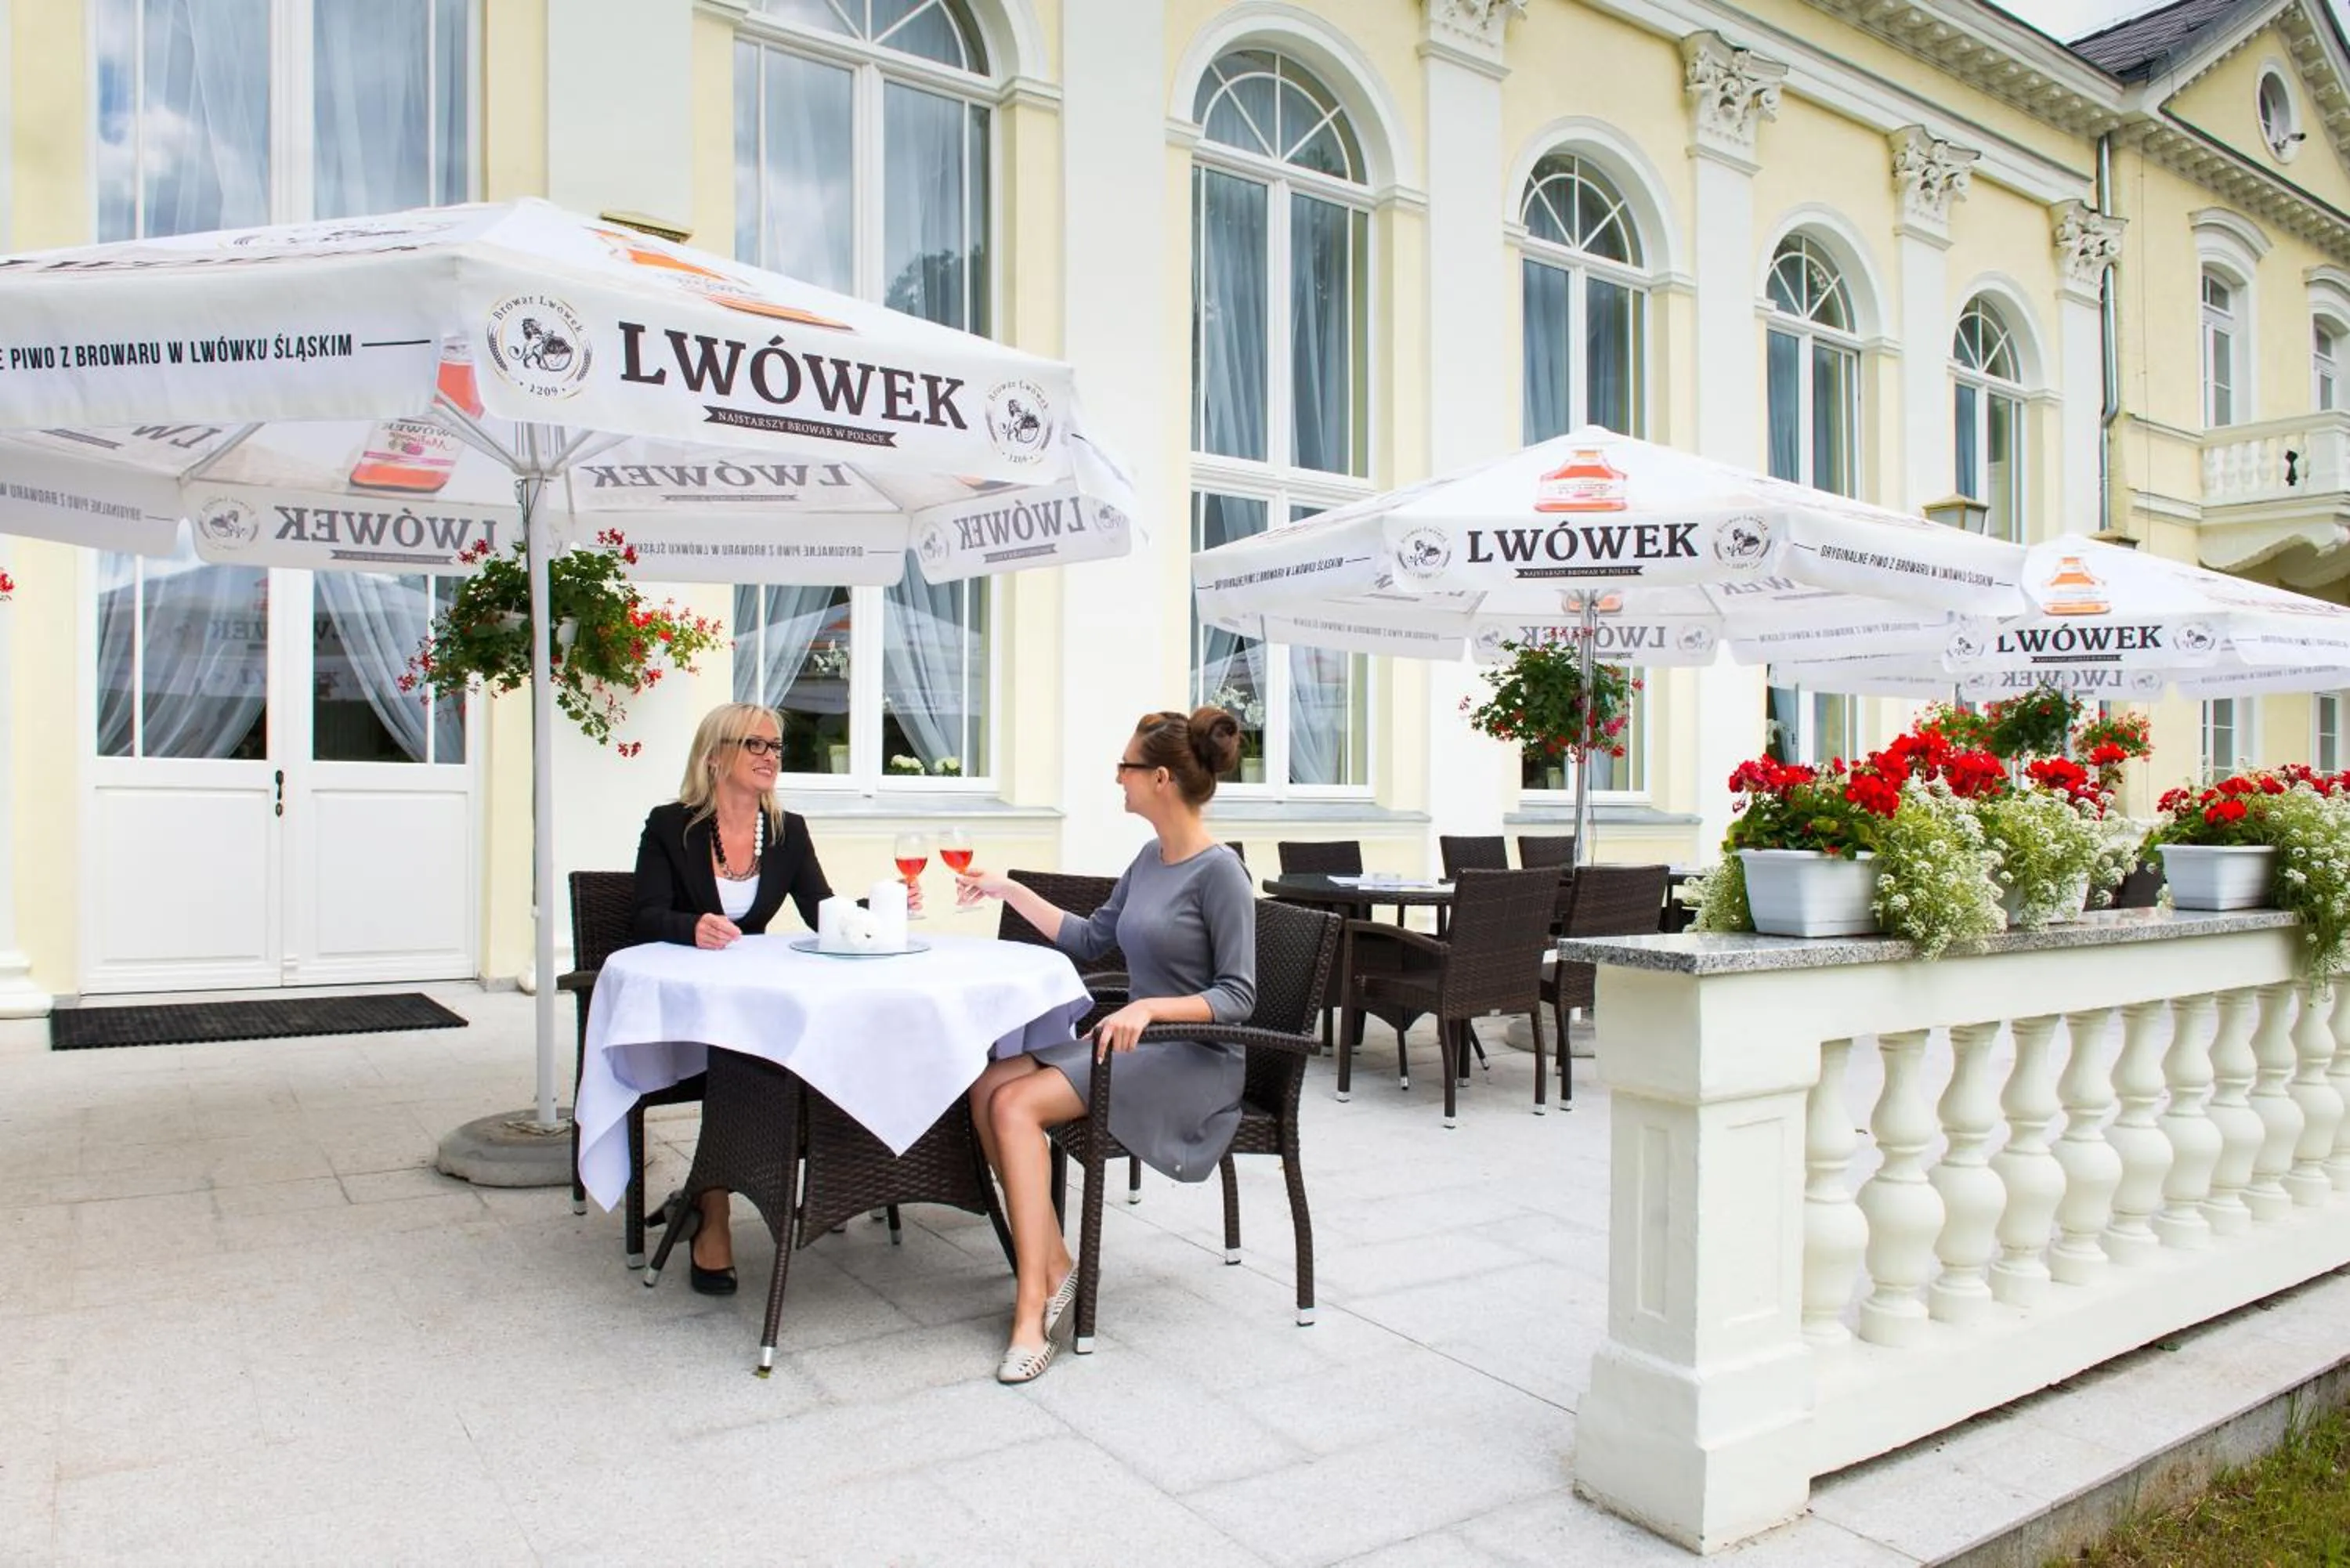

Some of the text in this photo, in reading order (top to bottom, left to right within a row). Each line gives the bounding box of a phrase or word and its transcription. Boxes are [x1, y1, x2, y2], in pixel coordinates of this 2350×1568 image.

[10, 346, 56, 370] PIWO
[60, 345, 71, 367] Z
[75, 342, 161, 367] BROWARU
[168, 341, 183, 364] W
[190, 336, 267, 363] LWÓWKU
[273, 334, 352, 362] ŚLĄSKIM
[618, 320, 967, 430] LWÓWEK
[718, 410, 886, 444] NAJSTARSZY BROWAR W POLSCE
[1467, 521, 1699, 562] LWÓWEK
[1996, 623, 2163, 652] LWÓWEK
